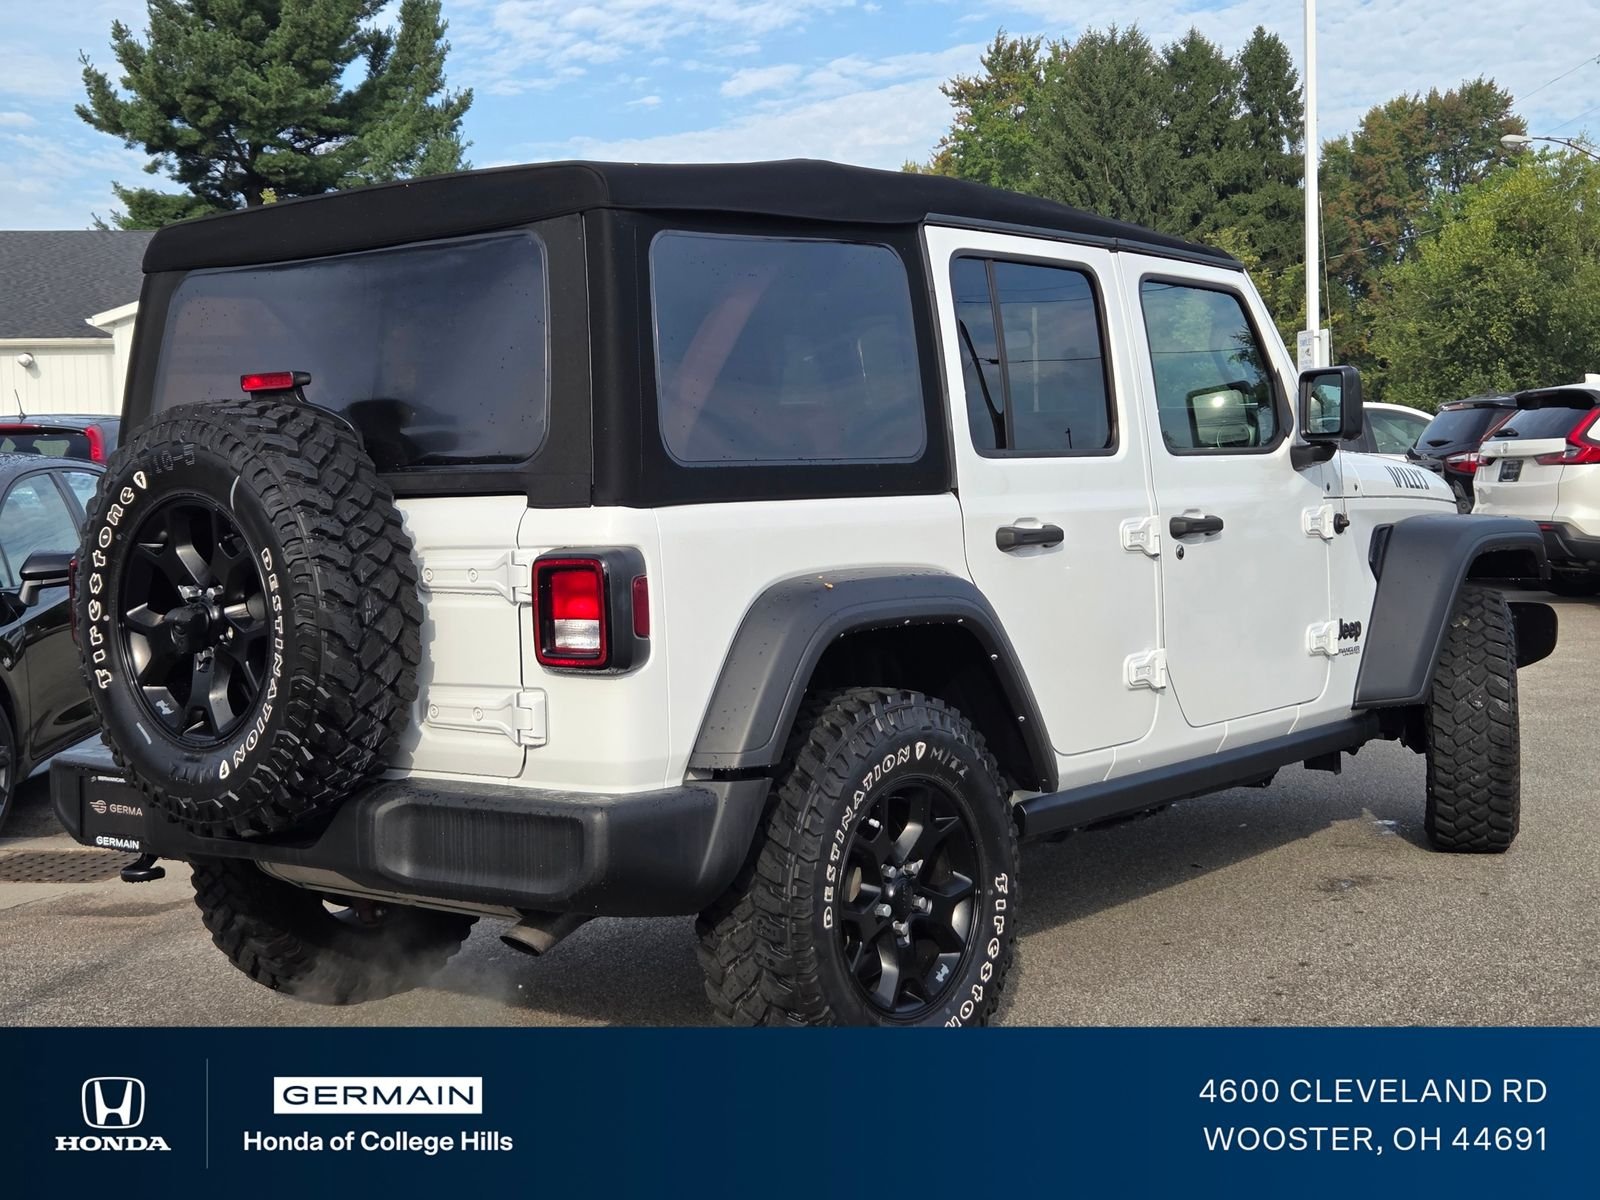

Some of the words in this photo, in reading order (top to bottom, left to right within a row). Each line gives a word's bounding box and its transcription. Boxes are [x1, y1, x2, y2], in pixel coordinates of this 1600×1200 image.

[1384, 465, 1430, 490] WILLYS
[1338, 618, 1361, 642] Jeep
[233, 547, 283, 768] DESTINATION
[109, 803, 143, 816] GERMA
[96, 836, 140, 850] GERMAIN
[823, 745, 910, 928] DESTINATION
